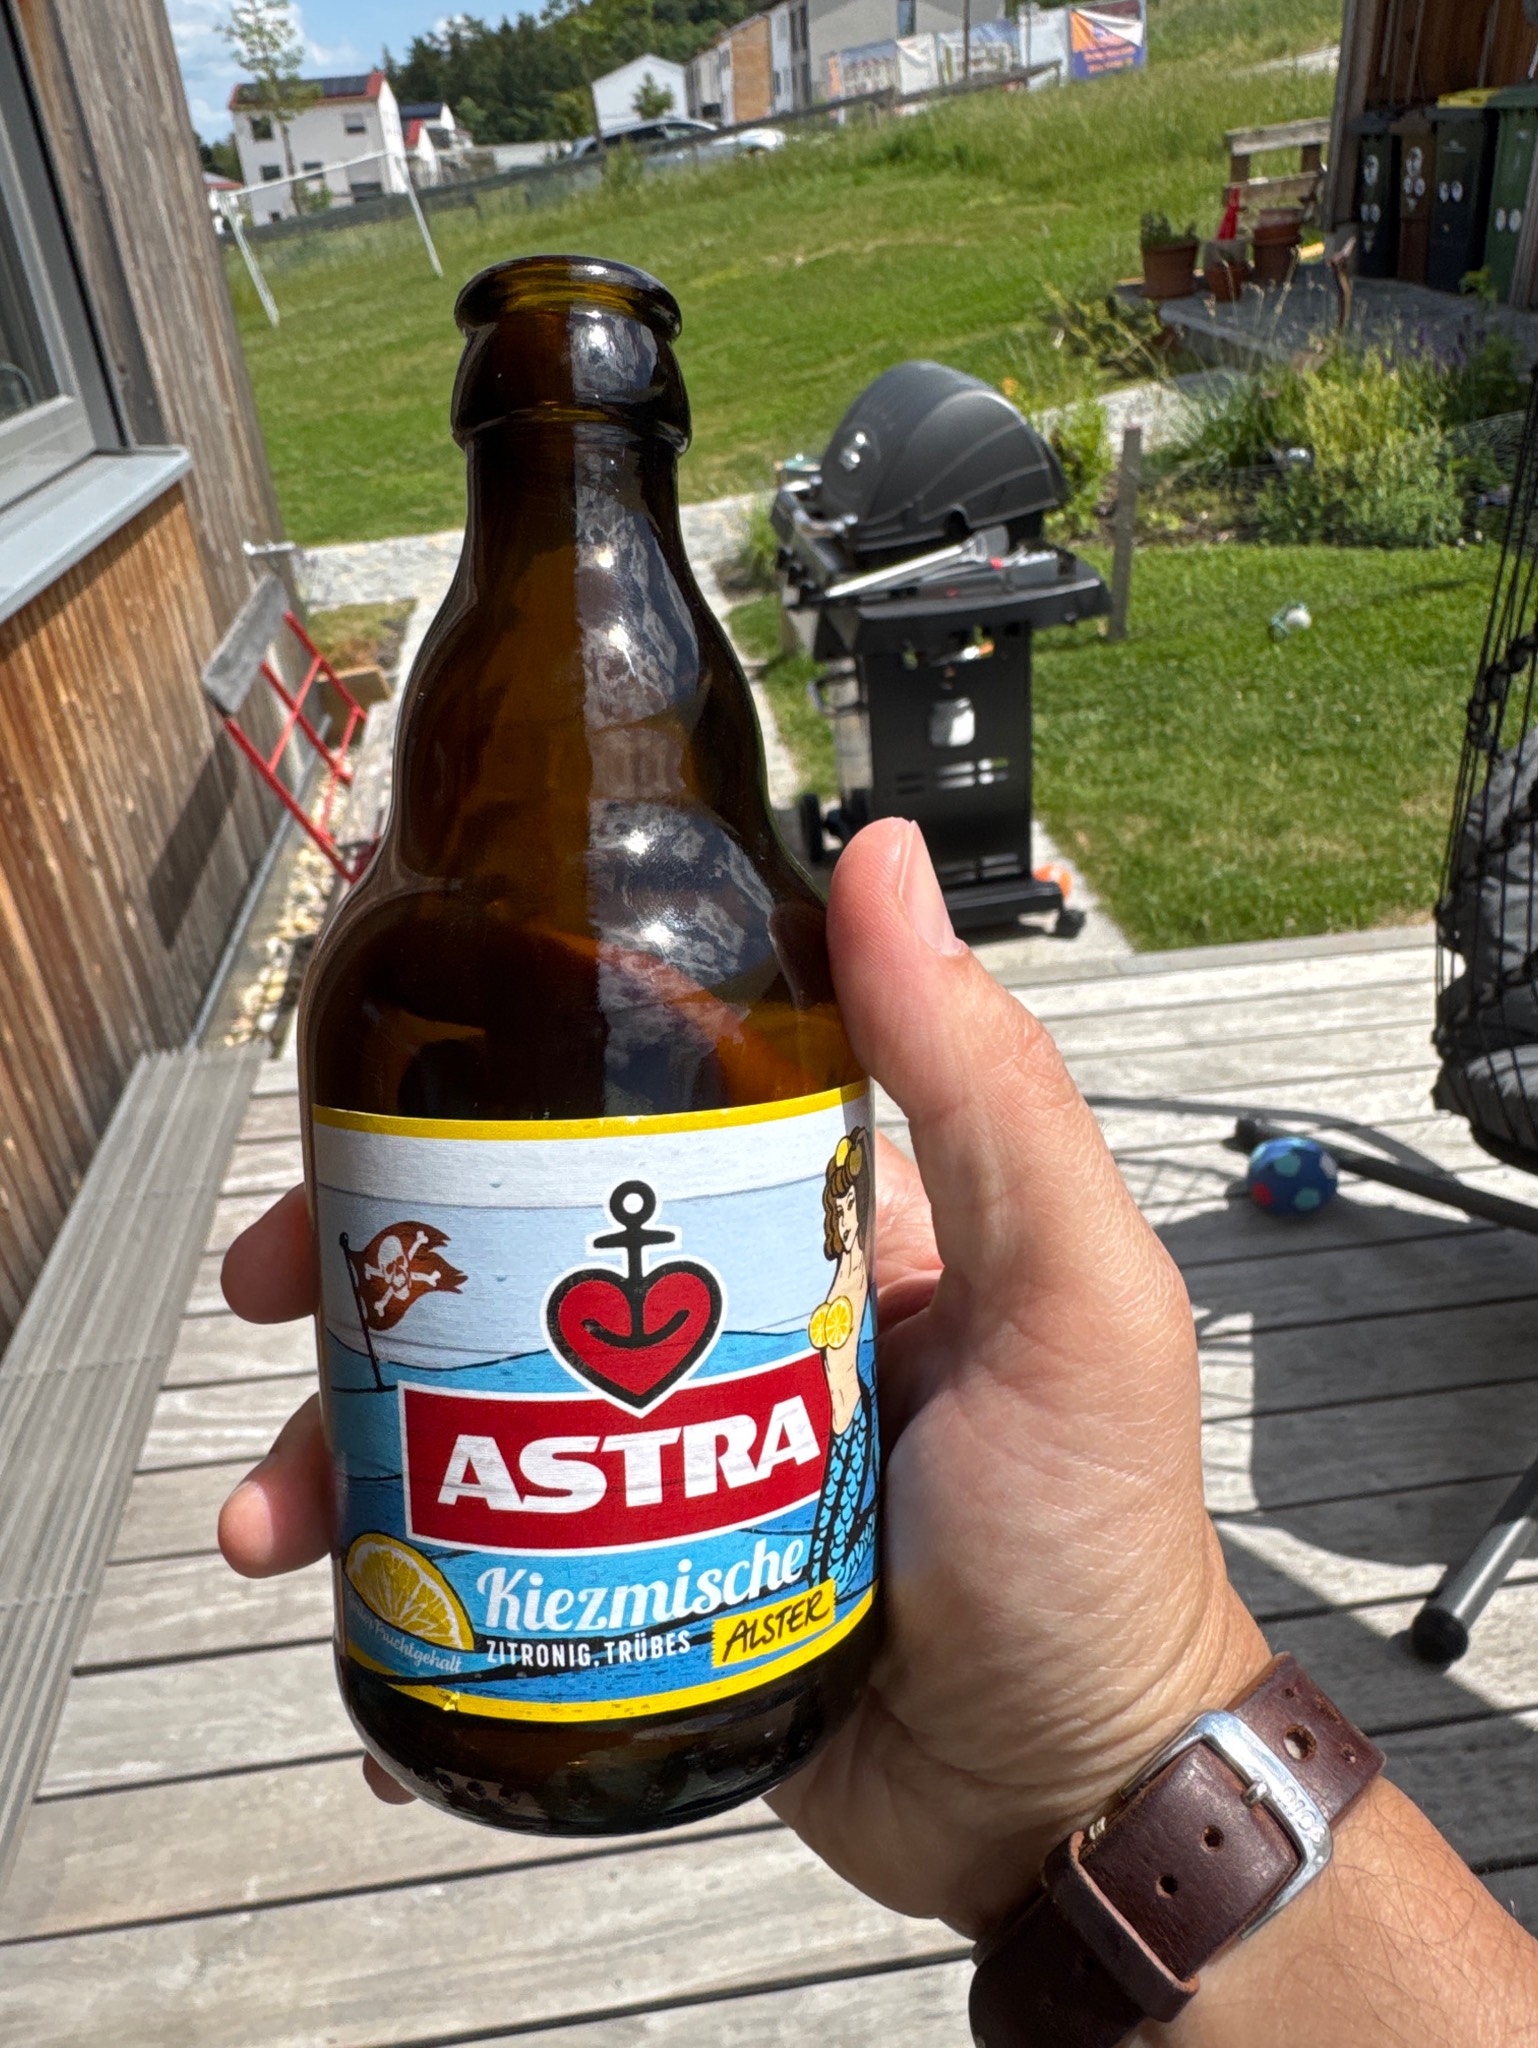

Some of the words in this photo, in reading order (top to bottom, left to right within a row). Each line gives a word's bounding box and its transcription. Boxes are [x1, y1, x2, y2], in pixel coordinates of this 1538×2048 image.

[437, 1395, 820, 1514] ASTRA
[476, 1538, 804, 1631] Kiezmische
[605, 1630, 691, 1664] TRÜBES
[722, 1590, 831, 1662] ALSTER
